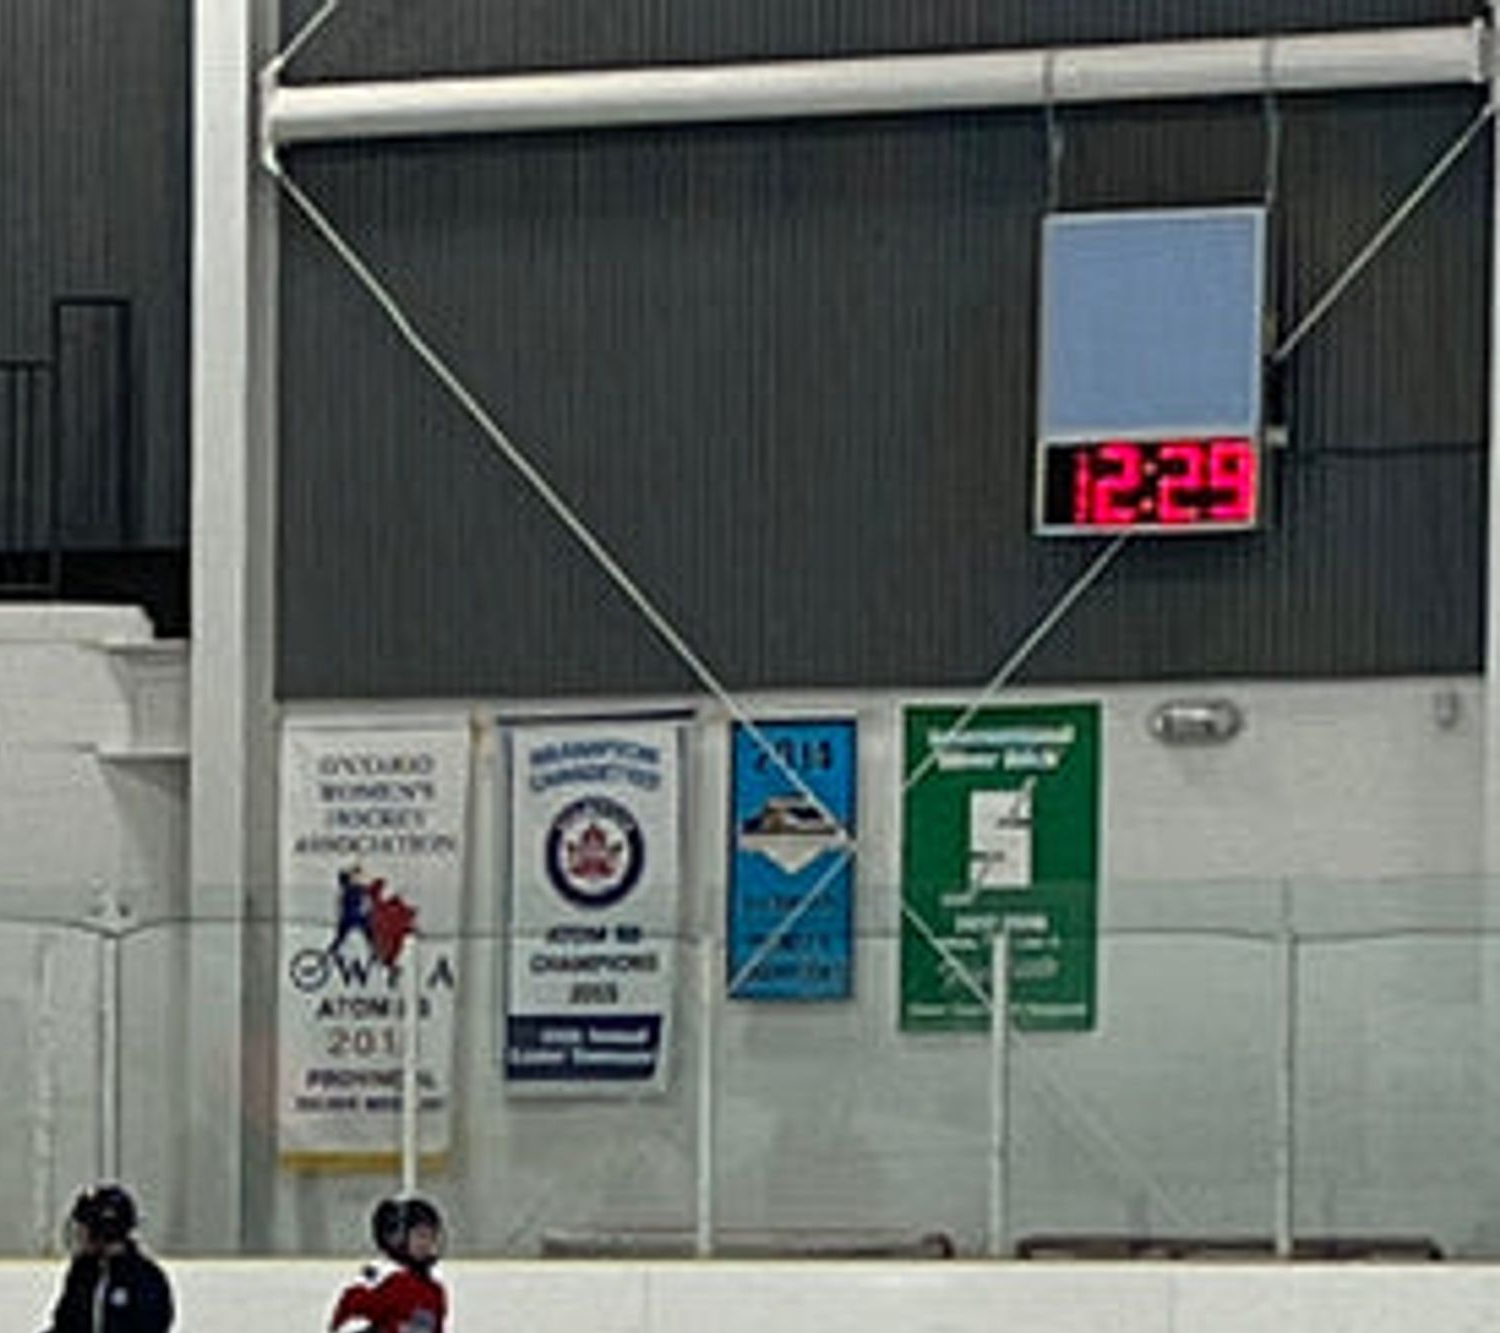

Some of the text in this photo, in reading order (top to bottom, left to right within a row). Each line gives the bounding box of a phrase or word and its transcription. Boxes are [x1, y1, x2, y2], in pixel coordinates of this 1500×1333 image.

[1073, 439, 1258, 525] 12:29
[318, 753, 435, 775] ONTARIO
[328, 807, 427, 829] HOCKEY
[294, 833, 456, 855] ASSOCIATION
[316, 998, 390, 1019] ATOM
[326, 1025, 419, 1056] 201
